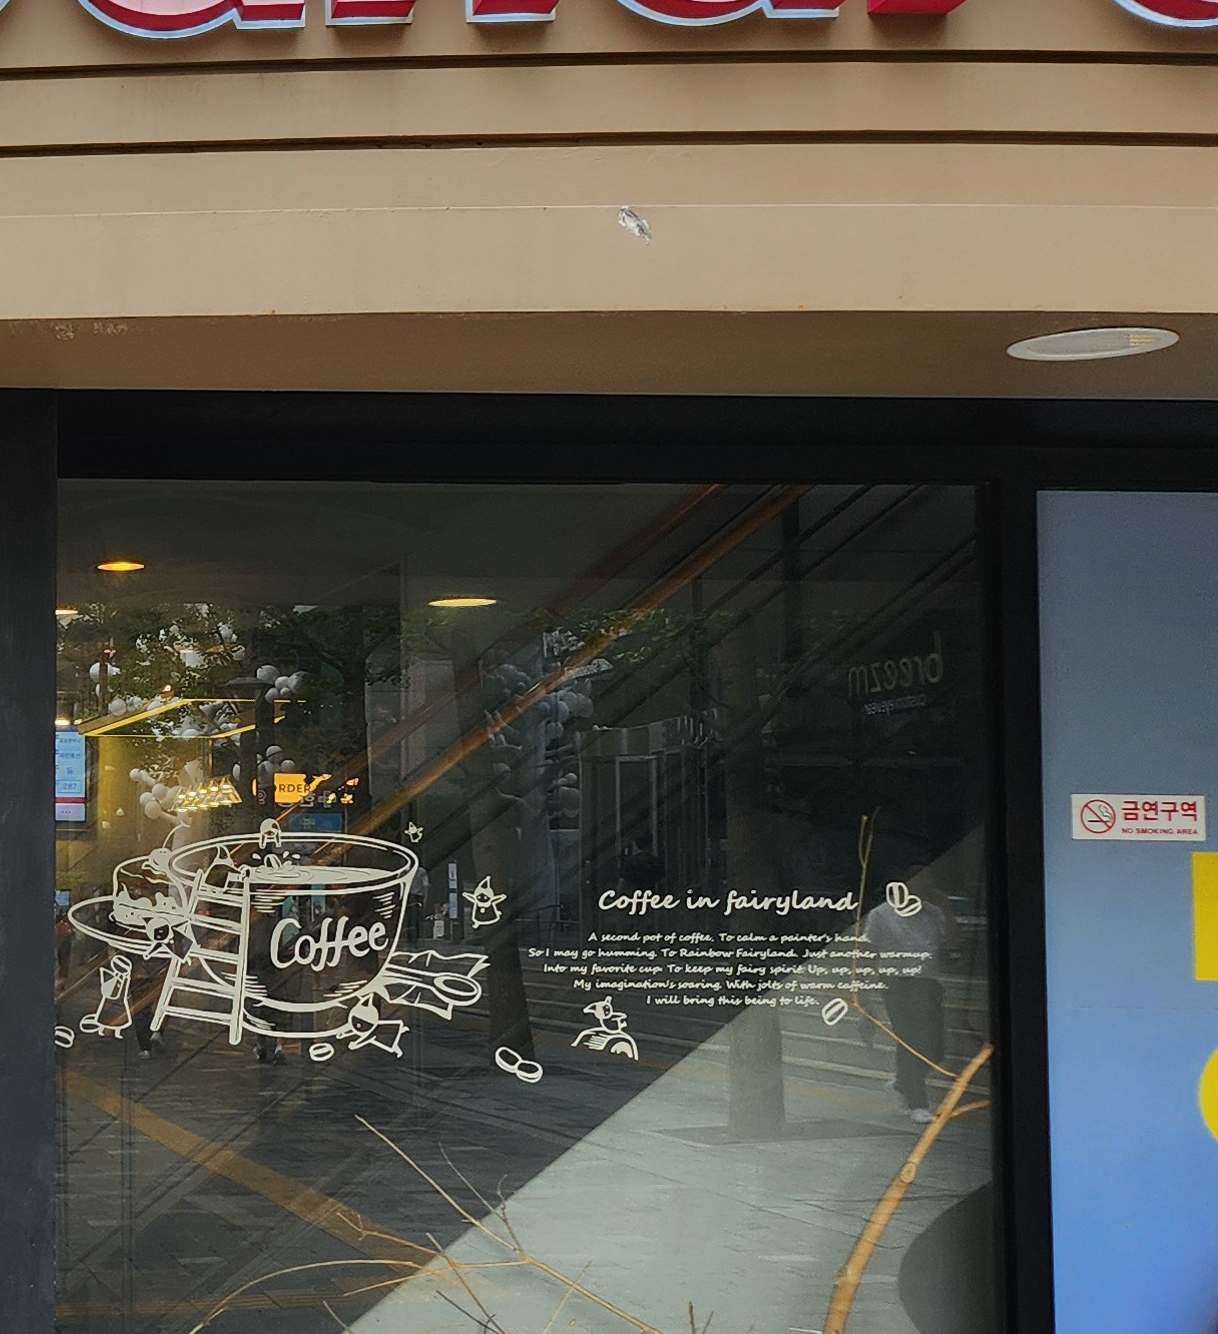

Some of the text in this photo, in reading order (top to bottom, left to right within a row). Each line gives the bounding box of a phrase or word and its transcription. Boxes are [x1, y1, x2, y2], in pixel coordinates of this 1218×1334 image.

[1121, 800, 1197, 821] 금연구역
[598, 889, 859, 915] Coffee in fairyland
[270, 916, 389, 971] Coffee
[588, 932, 598, 942] A
[601, 933, 641, 941] second
[643, 933, 661, 944] pot
[664, 933, 676, 944] of
[679, 933, 714, 944] coffee.
[719, 933, 735, 941] To
[737, 933, 767, 942] calm
[554, 950, 579, 959] may
[581, 950, 596, 960] go
[598, 948, 657, 960] humming.
[661, 949, 676, 958] To
[680, 948, 733, 958] Rainbow
[736, 949, 798, 960] Fairyland.
[544, 964, 568, 973] Into
[570, 966, 587, 975] my
[591, 964, 637, 975] favorite
[667, 965, 683, 973] To
[685, 964, 713, 975] keep
[716, 966, 733, 975] my
[736, 965, 765, 976] fairy
[574, 980, 591, 991] My
[596, 980, 675, 991] imagination's
[678, 980, 722, 991] soaring.
[726, 981, 756, 989] With
[756, 980, 783, 992] jolts
[785, 981, 797, 992] of
[655, 996, 680, 1004] will
[683, 996, 714, 1007] bring
[718, 996, 742, 1005] this
[745, 996, 777, 1007] being
[779, 997, 792, 1005] to
[795, 996, 819, 1007] life.
